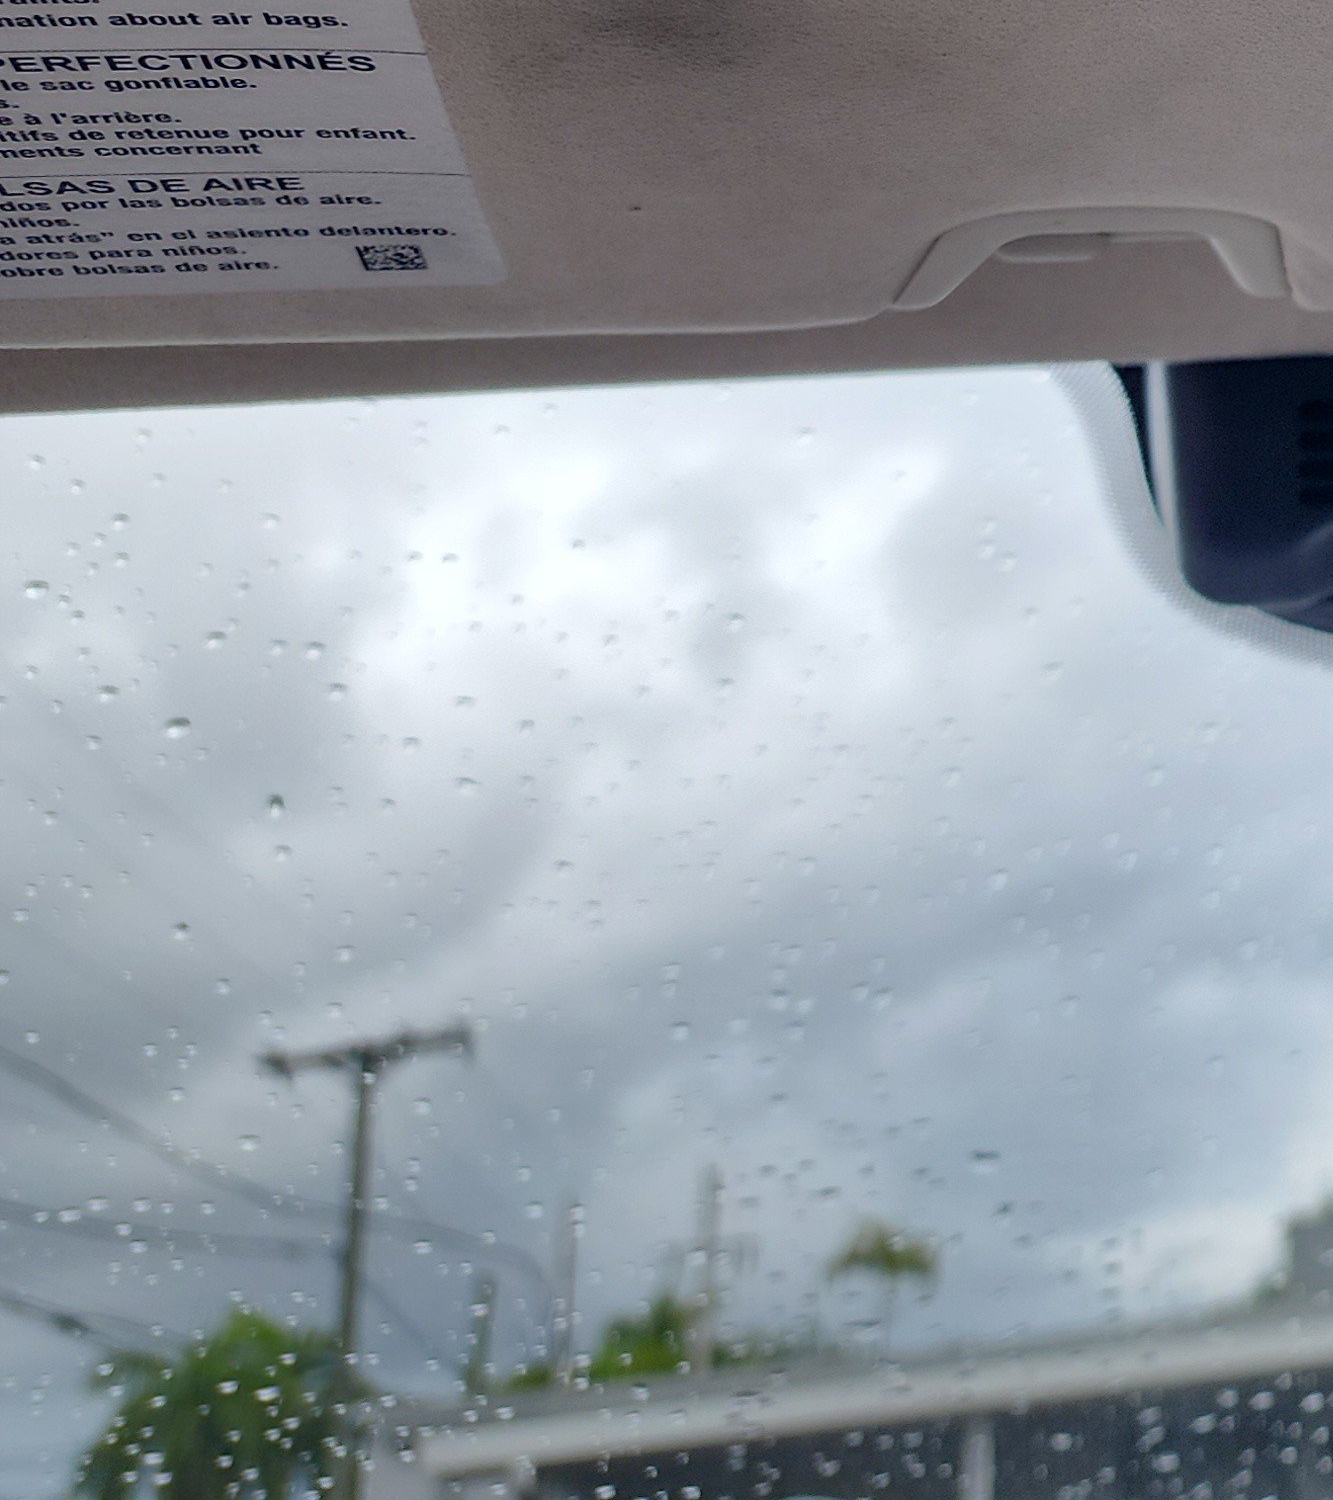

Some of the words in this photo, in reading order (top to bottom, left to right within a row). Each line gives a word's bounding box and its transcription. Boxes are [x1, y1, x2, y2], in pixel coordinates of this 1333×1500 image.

[108, 13, 202, 26] about
[211, 12, 252, 25] air
[262, 12, 348, 28] bags.
[0, 52, 376, 73] ERFECTIONNÉS
[39, 80, 95, 91] sac
[104, 76, 257, 92] gonflable.
[24, 112, 42, 125] à
[68, 129, 105, 141] de
[115, 128, 230, 140] retenue
[239, 128, 305, 140] pour
[316, 127, 416, 140] enfant.
[94, 143, 262, 157] concernant
[0, 180, 116, 196] LSAS
[128, 179, 190, 193] DE
[203, 177, 304, 192] AIRE
[61, 200, 109, 212] por
[118, 198, 162, 209] las
[171, 196, 265, 208] bolsas
[276, 195, 309, 206] de
[319, 194, 382, 205] aire.
[127, 231, 162, 242] en
[171, 229, 196, 240] el
[206, 227, 309, 239] asiento
[319, 226, 456, 237] delantero.
[89, 249, 153, 260] para
[73, 264, 165, 276] bolsas
[175, 262, 208, 272] de
